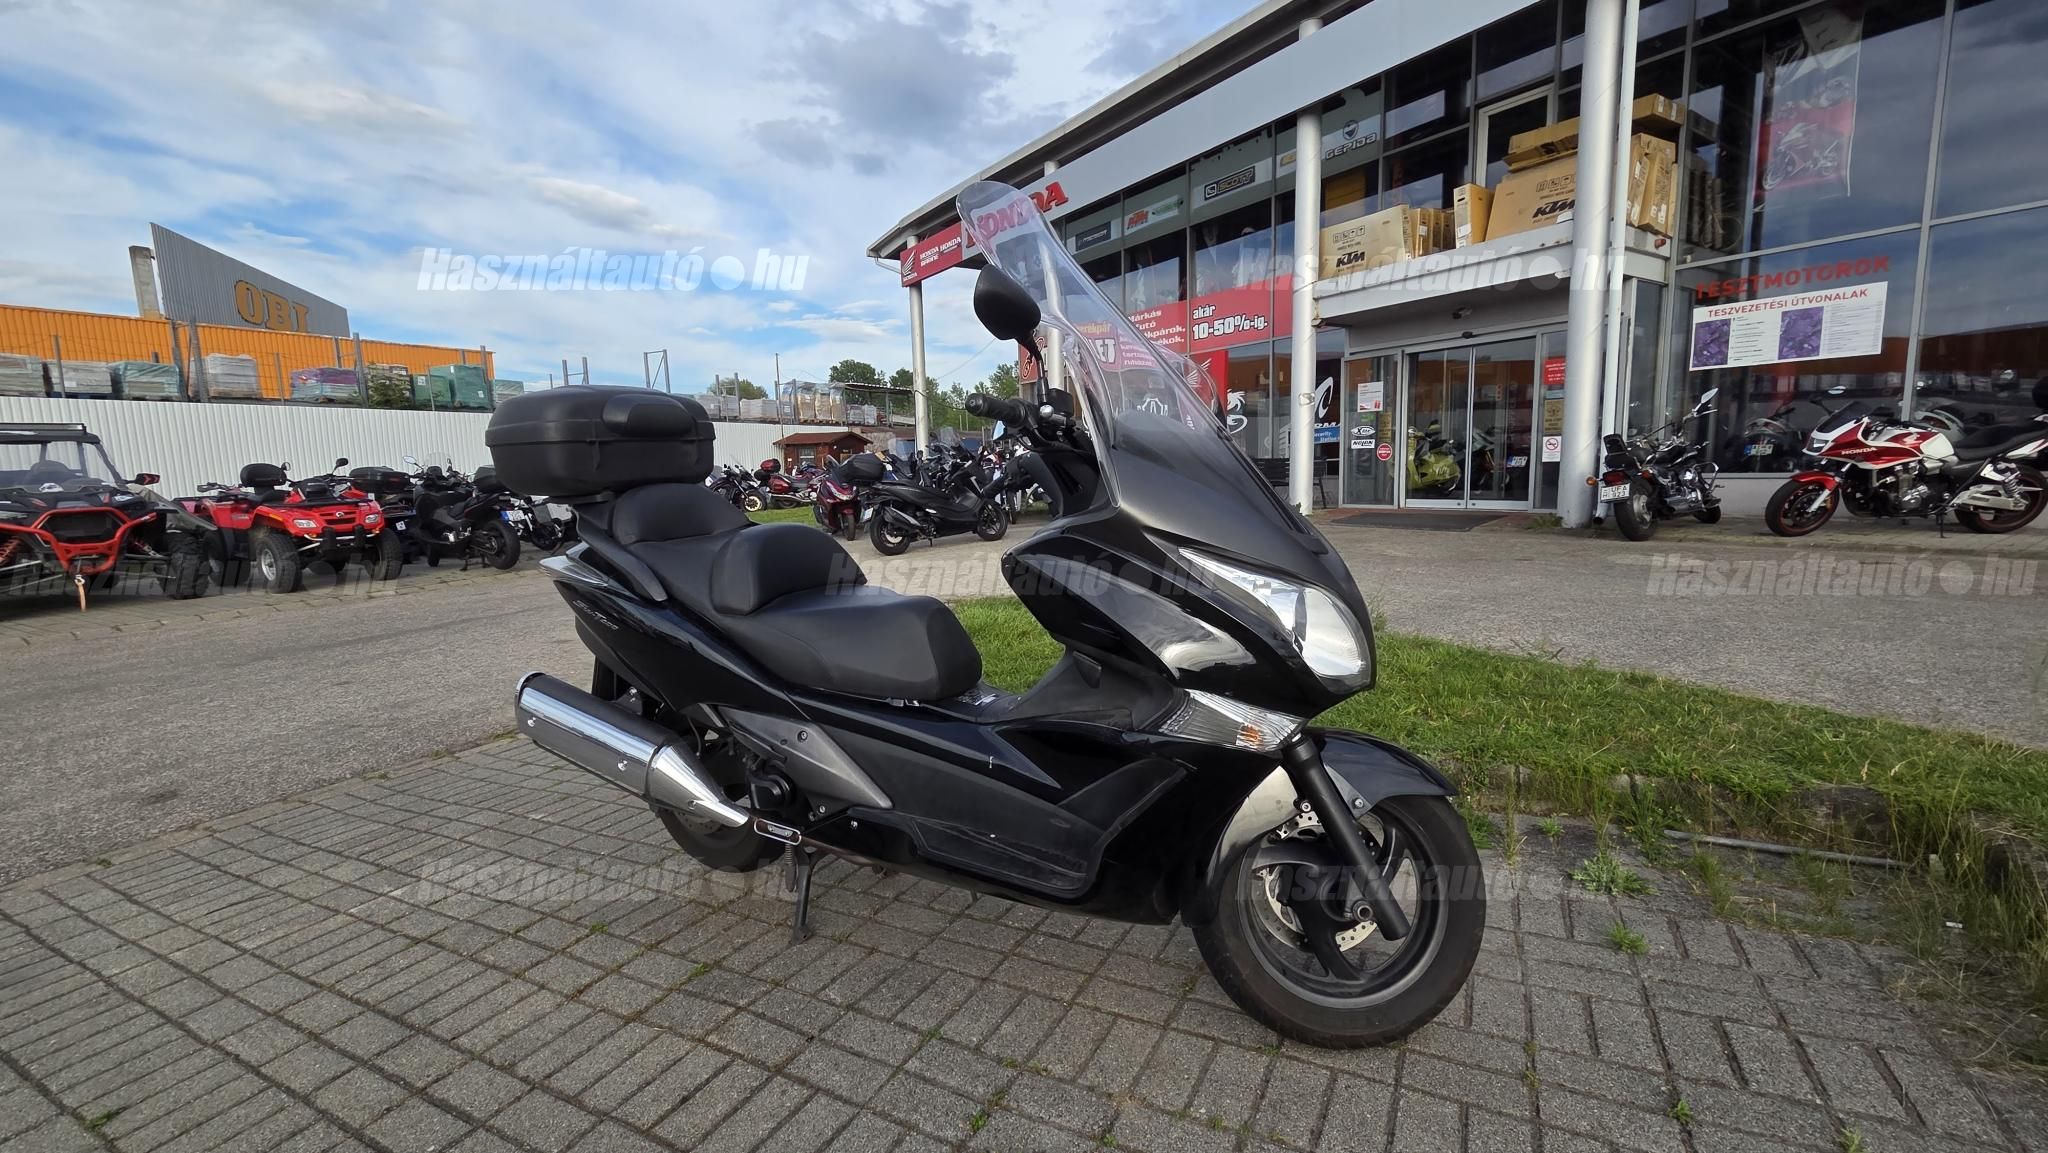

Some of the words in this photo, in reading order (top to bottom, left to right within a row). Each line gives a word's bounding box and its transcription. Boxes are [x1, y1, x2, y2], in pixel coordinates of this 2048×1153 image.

[1335, 250, 1366, 268] KTM
[1695, 255, 1891, 299] TESZTMOTOROK
[234, 279, 309, 332] OBI
[1192, 303, 1217, 320] akár
[1707, 300, 1788, 318] TESZVEZETÉSI
[1791, 287, 1869, 307] ÚTVONALAK
[1841, 446, 1877, 455] HONDA
